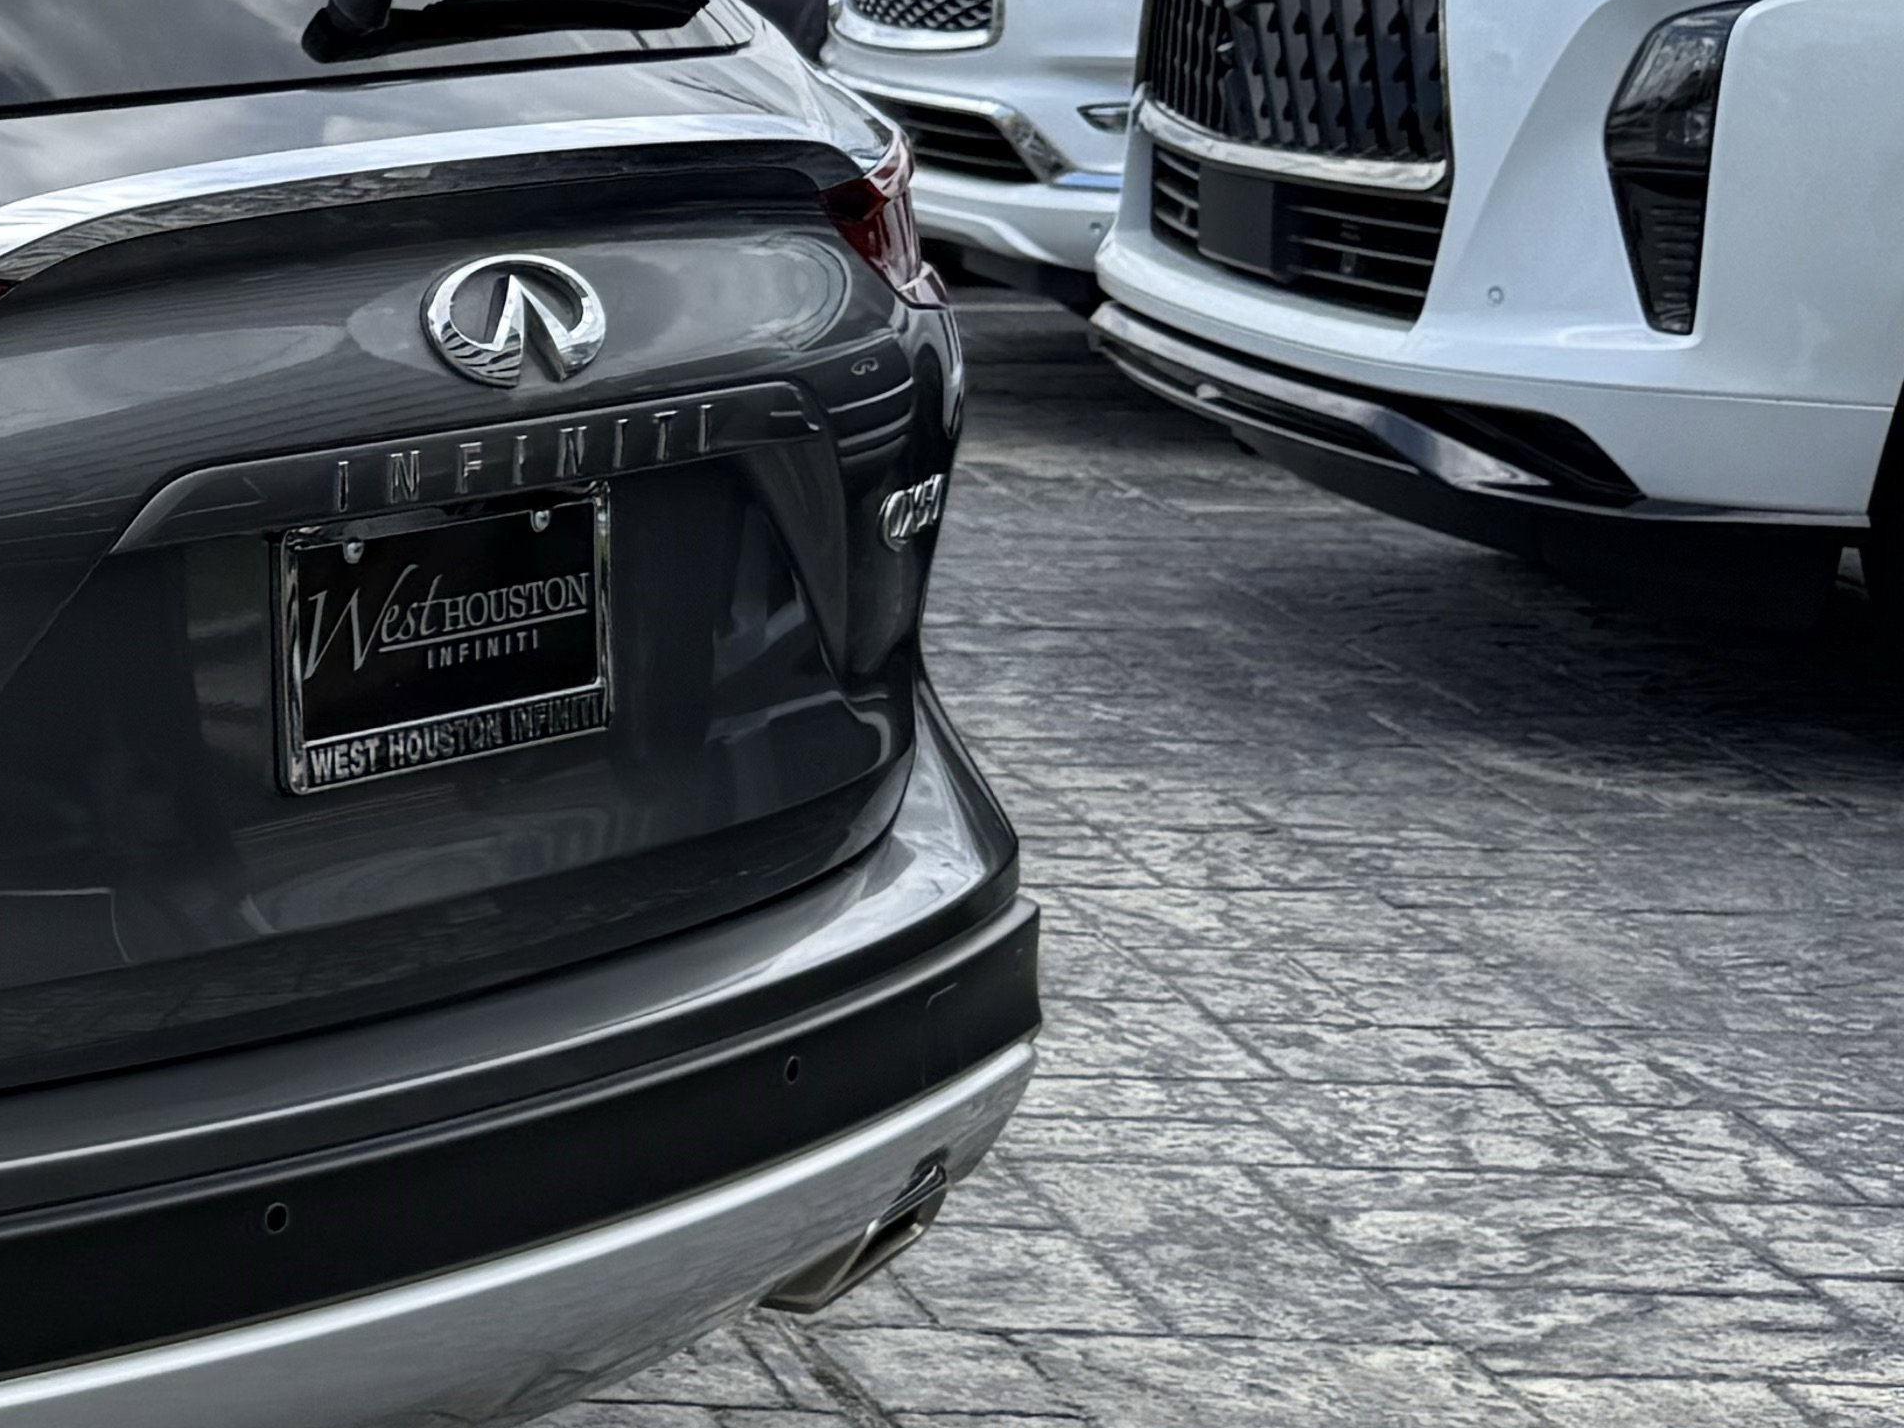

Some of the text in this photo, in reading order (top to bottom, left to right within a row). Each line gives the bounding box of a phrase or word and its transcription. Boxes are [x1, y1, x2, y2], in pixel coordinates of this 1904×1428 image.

[334, 404, 713, 512] INFINITI
[427, 629, 540, 670] INFINITI
[311, 693, 602, 784] WEST HOUSTON INFINITI
